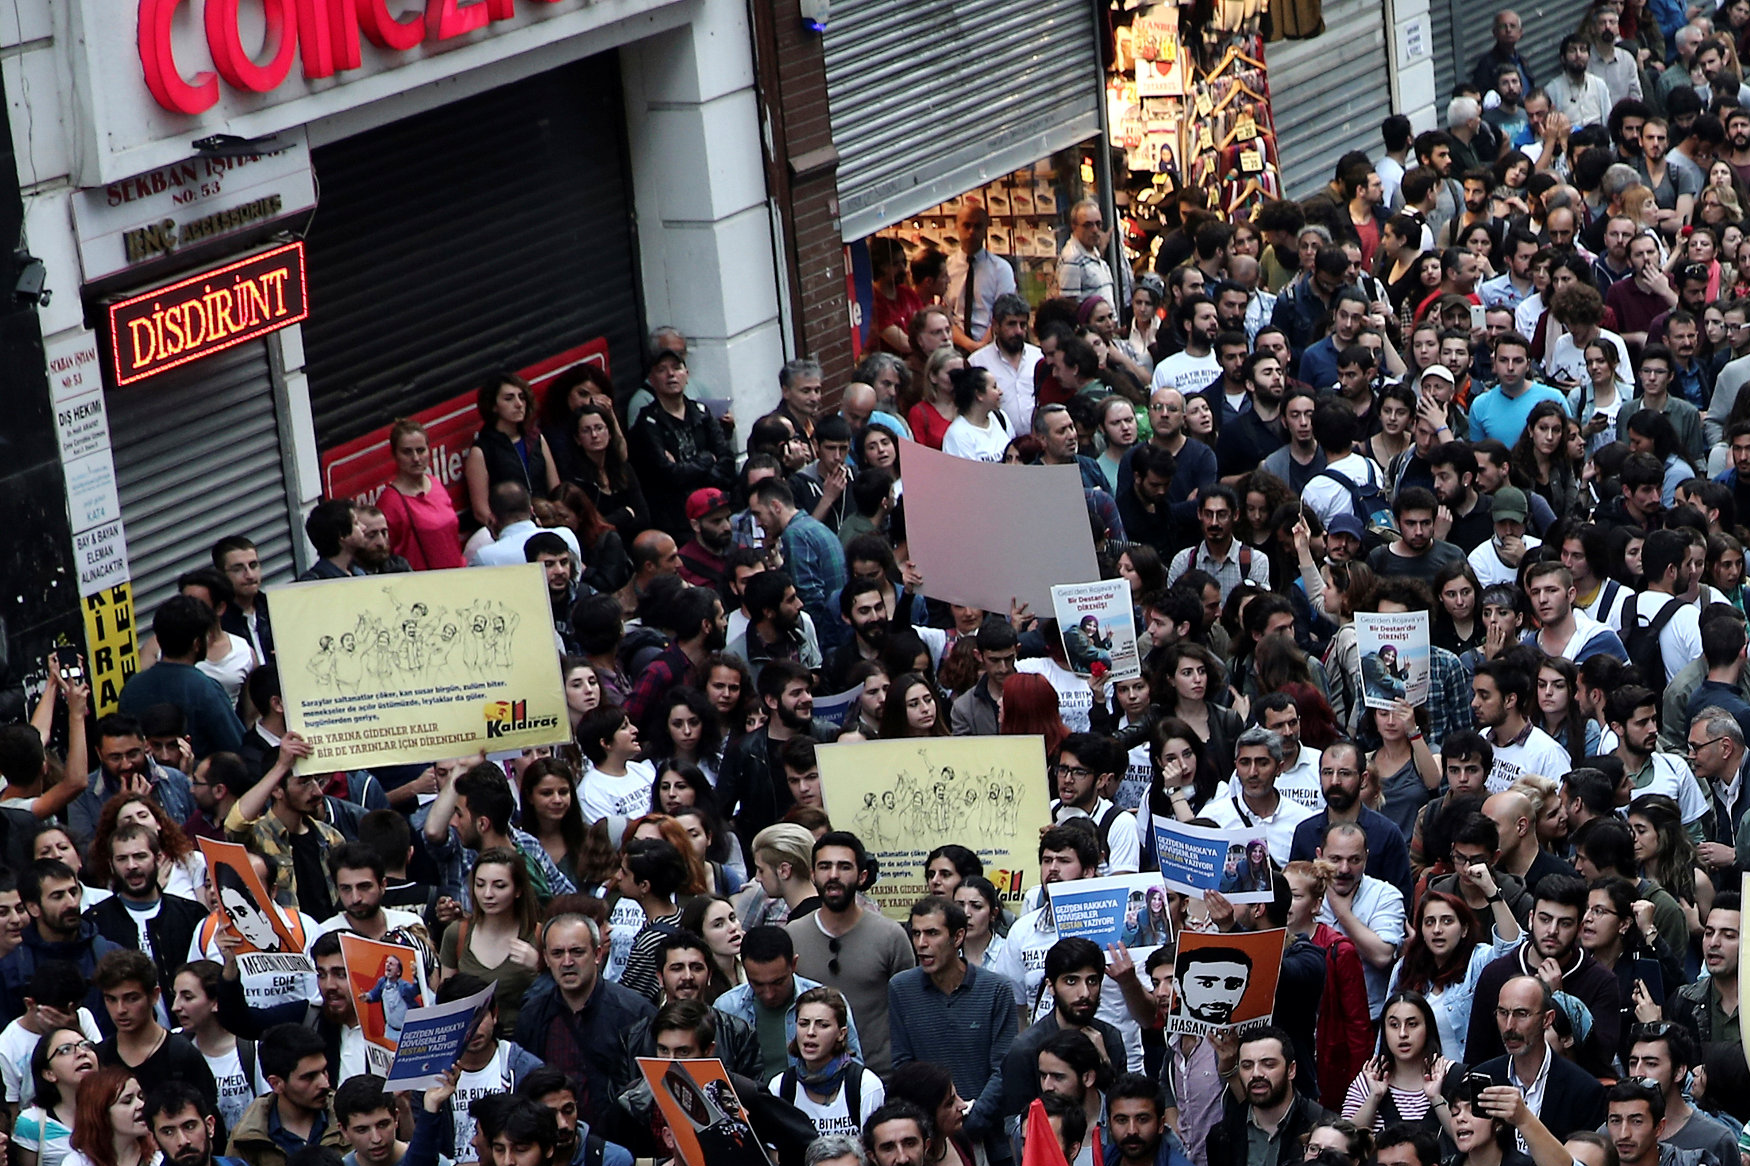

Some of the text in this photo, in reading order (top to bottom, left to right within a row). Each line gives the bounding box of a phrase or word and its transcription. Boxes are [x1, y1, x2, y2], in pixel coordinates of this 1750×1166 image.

[107, 162, 198, 207] SEKBAN
[201, 181, 221, 196] 53
[77, 534, 90, 551] BAY
[97, 525, 119, 543] BAYAN
[87, 545, 114, 565] ELEMAN
[82, 558, 124, 584] ALINACAKTIR
[301, 680, 507, 707] Saraylar saltanatlar çöker, kan susar birgün, zulüm biter.
[347, 704, 356, 712] de
[358, 703, 376, 713] açılır
[378, 699, 420, 709] üstümüzde,
[421, 695, 453, 705] leylaklar
[455, 693, 464, 701] da
[466, 692, 487, 701] güler.
[304, 714, 380, 728] bugünlerden geriye,
[487, 699, 558, 738] Kaldıraç
[307, 722, 438, 745] BİR YARINA GİDENLER KALIR
[317, 747, 334, 758] BİR
[335, 746, 347, 756] DE
[348, 741, 397, 755] YARINLAR
[399, 738, 418, 751] İÇİN
[871, 885, 899, 895] YARINA
[1170, 1018, 1208, 1036] HASAN
